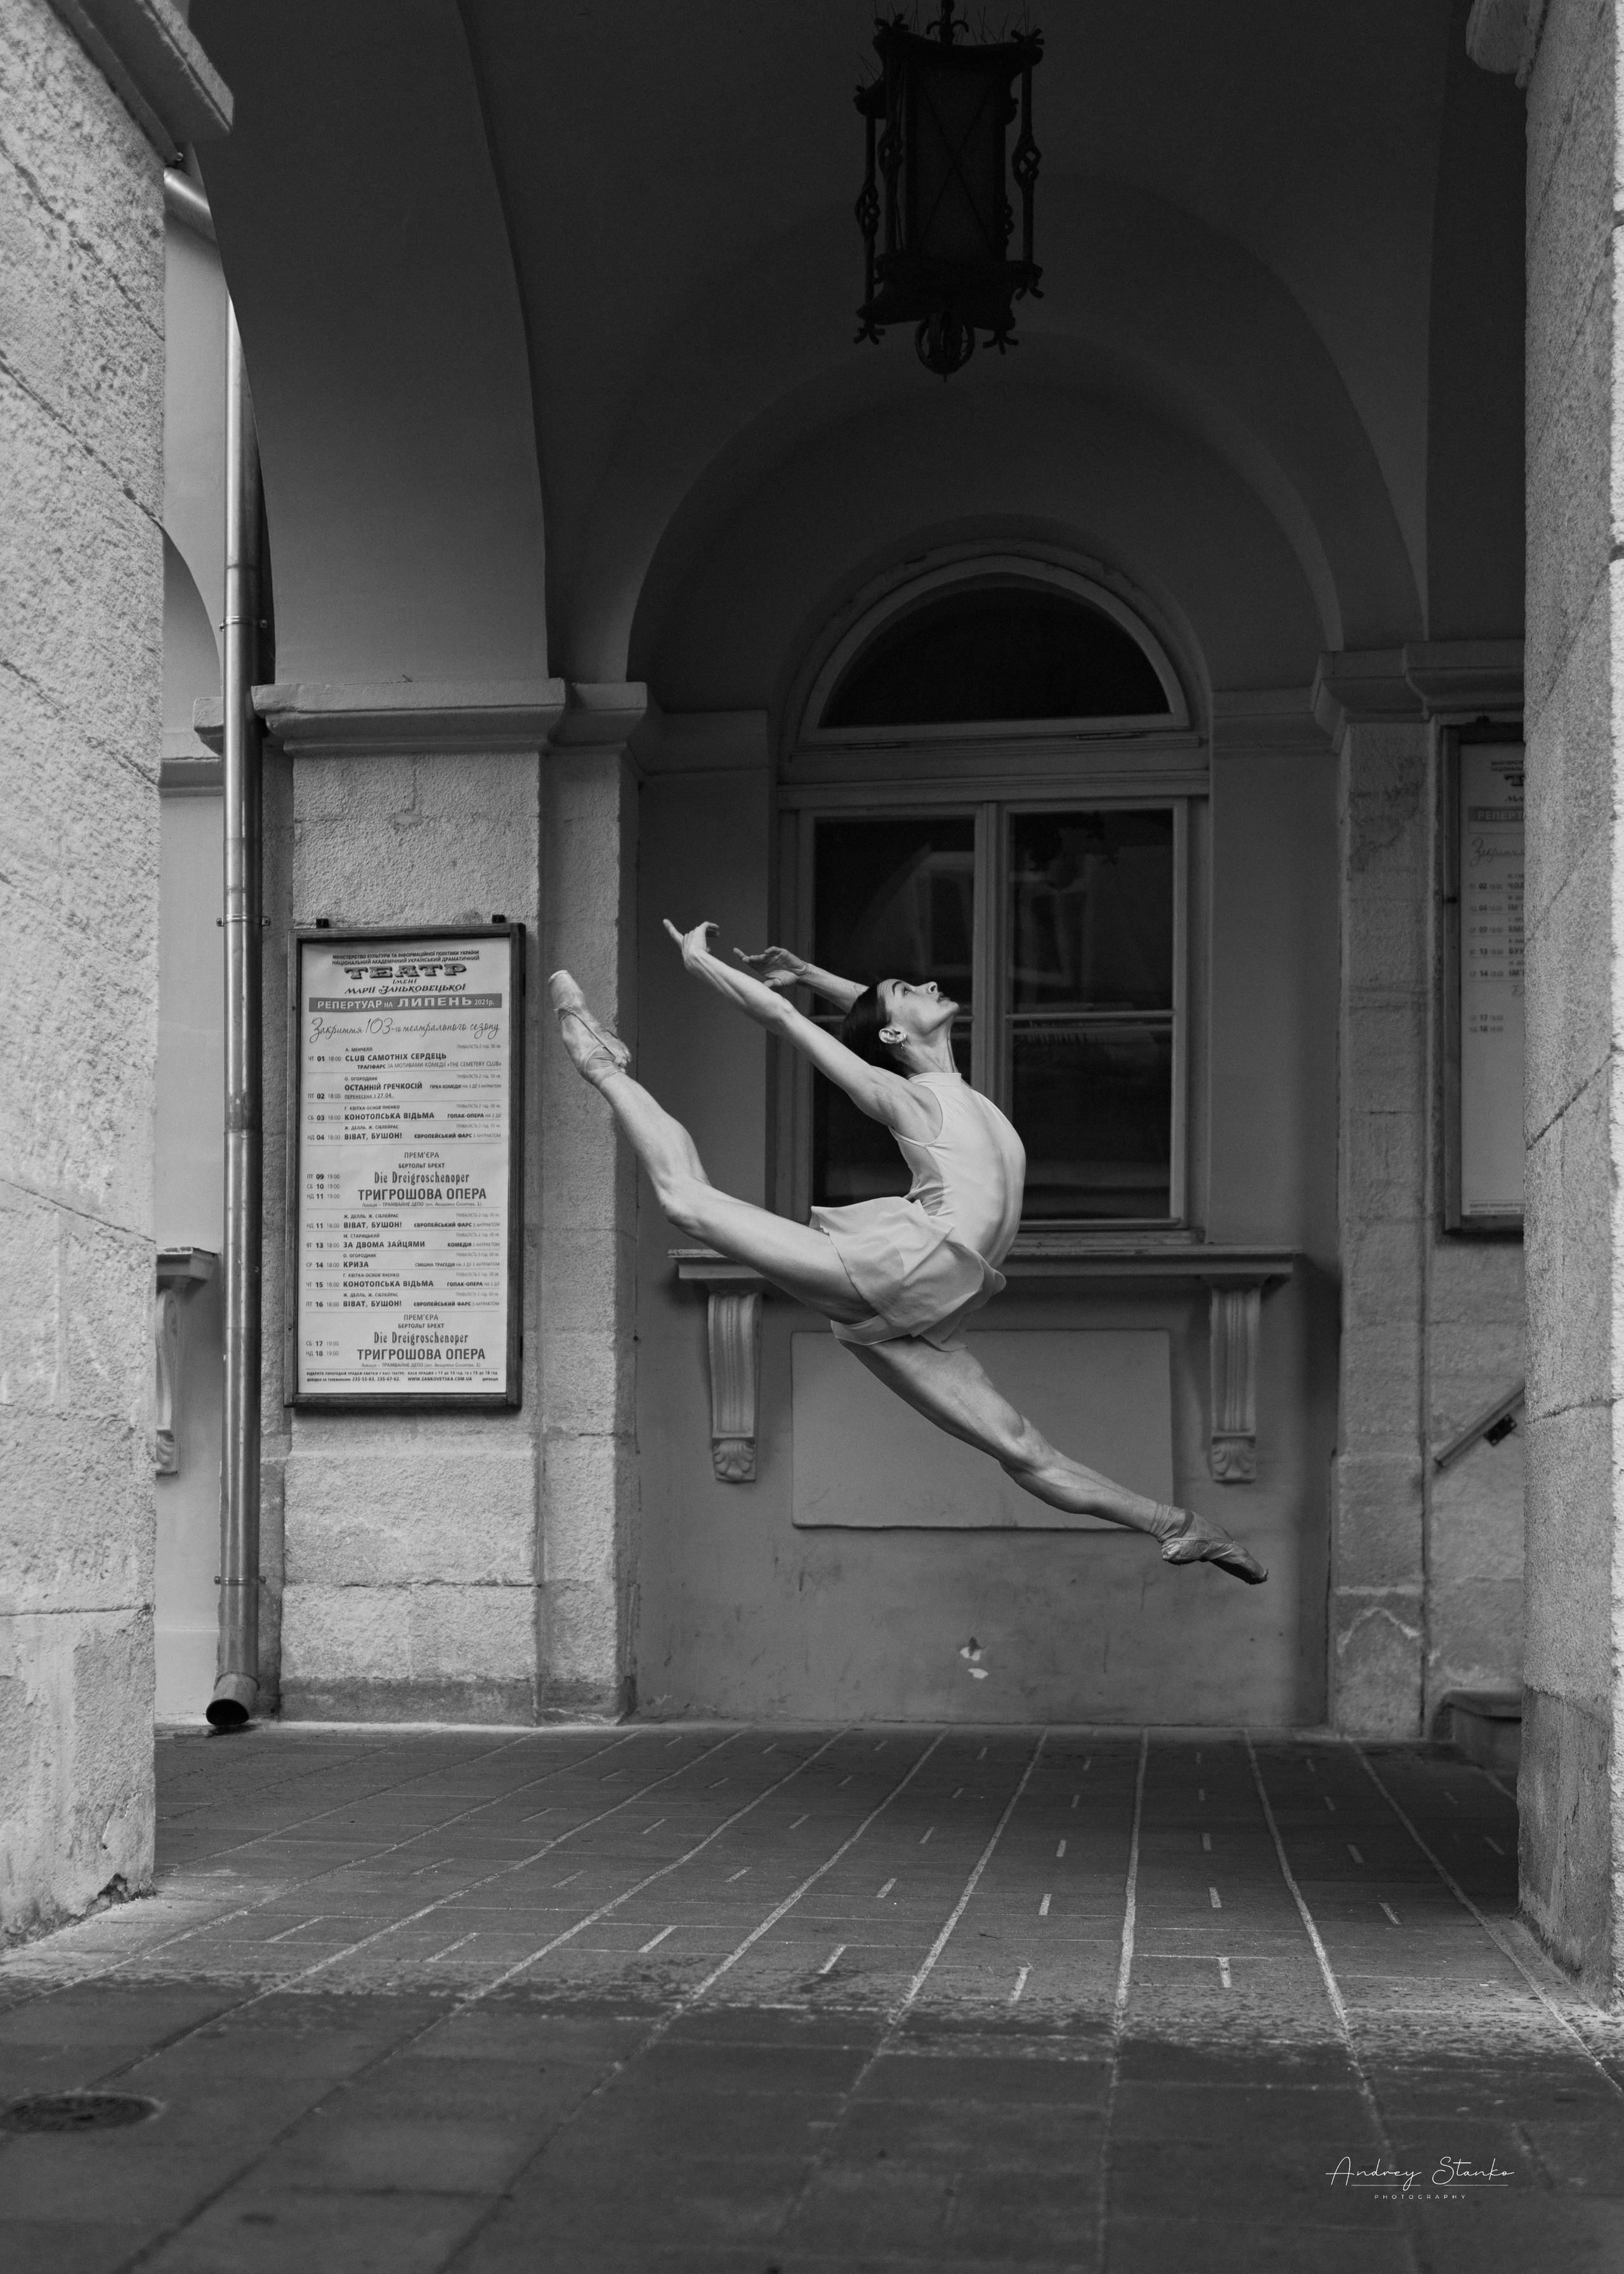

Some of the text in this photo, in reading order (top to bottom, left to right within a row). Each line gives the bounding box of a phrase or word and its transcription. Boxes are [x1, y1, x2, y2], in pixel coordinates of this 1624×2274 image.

[1477, 810, 1524, 819] РЕПЕРТ
[344, 963, 466, 980] ТЕАТР
[378, 983, 466, 994] ЗАНЬКОВЕЦЬКОЇ
[317, 1000, 382, 1009] РЕПЕРТУАР
[397, 996, 471, 1006] ЛИПЕНЬ
[309, 1017, 363, 1042] Закриття
[403, 1023, 467, 1037] театрального
[470, 1023, 499, 1039] сезону
[374, 1171, 469, 1184] Die Dreigroschenoper
[358, 1188, 486, 1200] ТРИГРОШОВА ОПЕРА
[374, 1332, 468, 1344] Die Dreigroschenoper
[357, 1348, 485, 1359] ТРИГРОШОВА ОПЕРА
